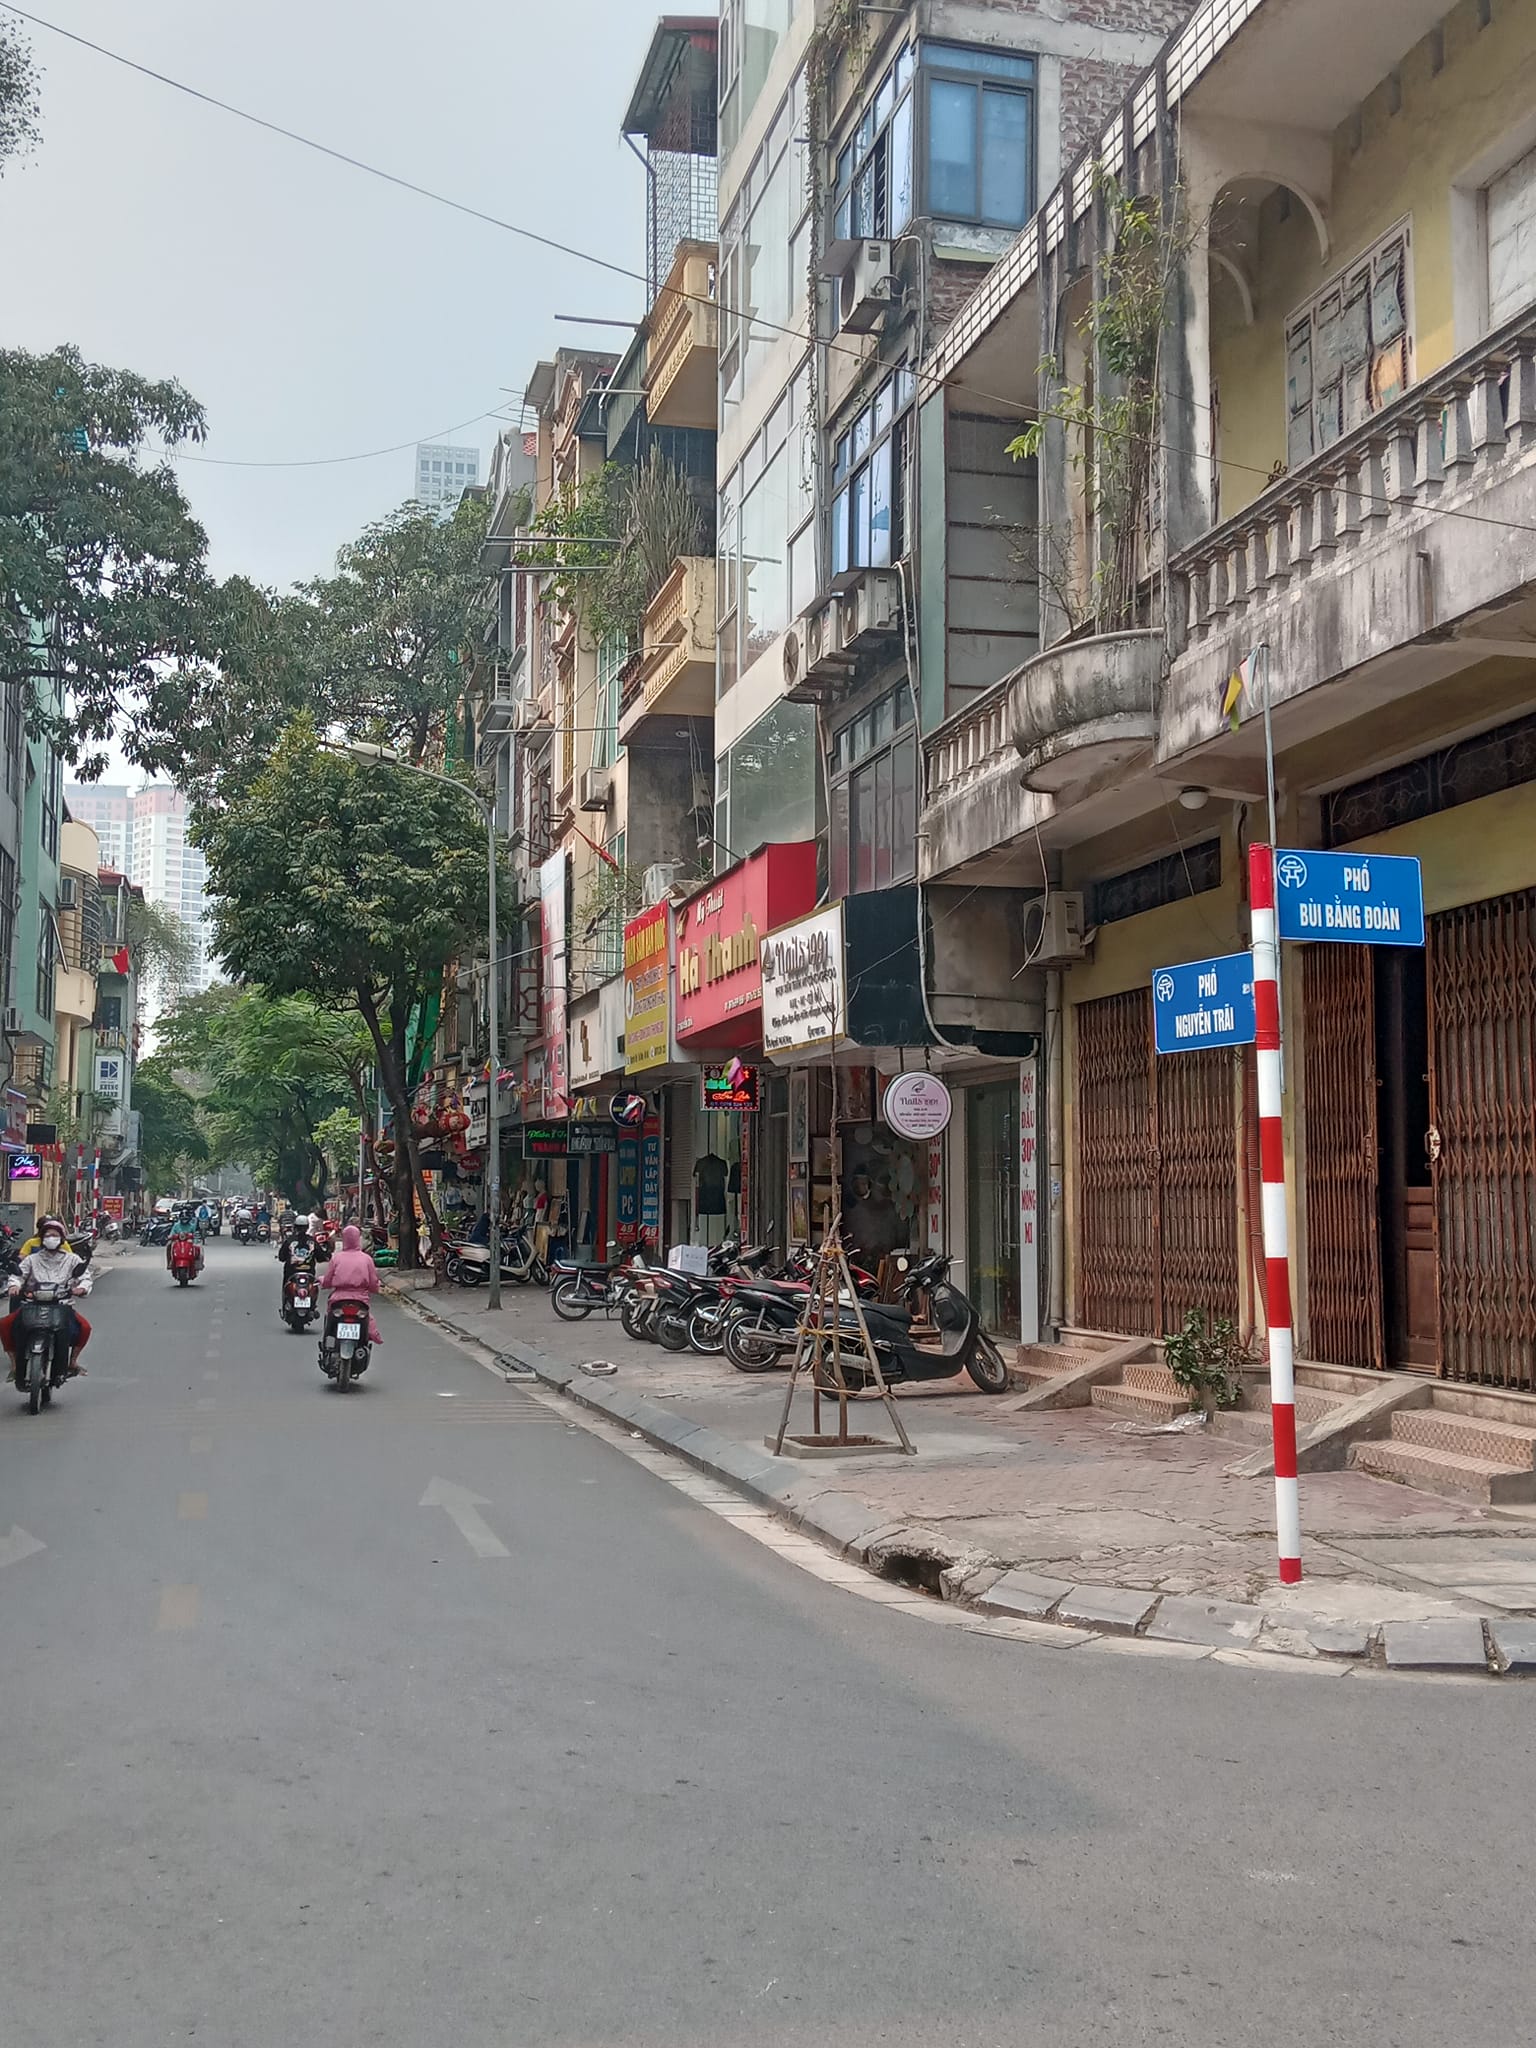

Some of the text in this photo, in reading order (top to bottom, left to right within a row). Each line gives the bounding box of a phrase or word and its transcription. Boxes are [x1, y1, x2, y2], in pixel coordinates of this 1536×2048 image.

[1343, 859, 1371, 892] PHỐ
[1299, 895, 1401, 931] BÙI BẰNG ĐOÀN
[703, 911, 758, 984] Thanh
[1198, 963, 1218, 998] PHỐ
[1175, 1003, 1234, 1039] NGUYỄN TRÃI
[621, 1194, 634, 1215] PC
[644, 1227, 657, 1237] 49
